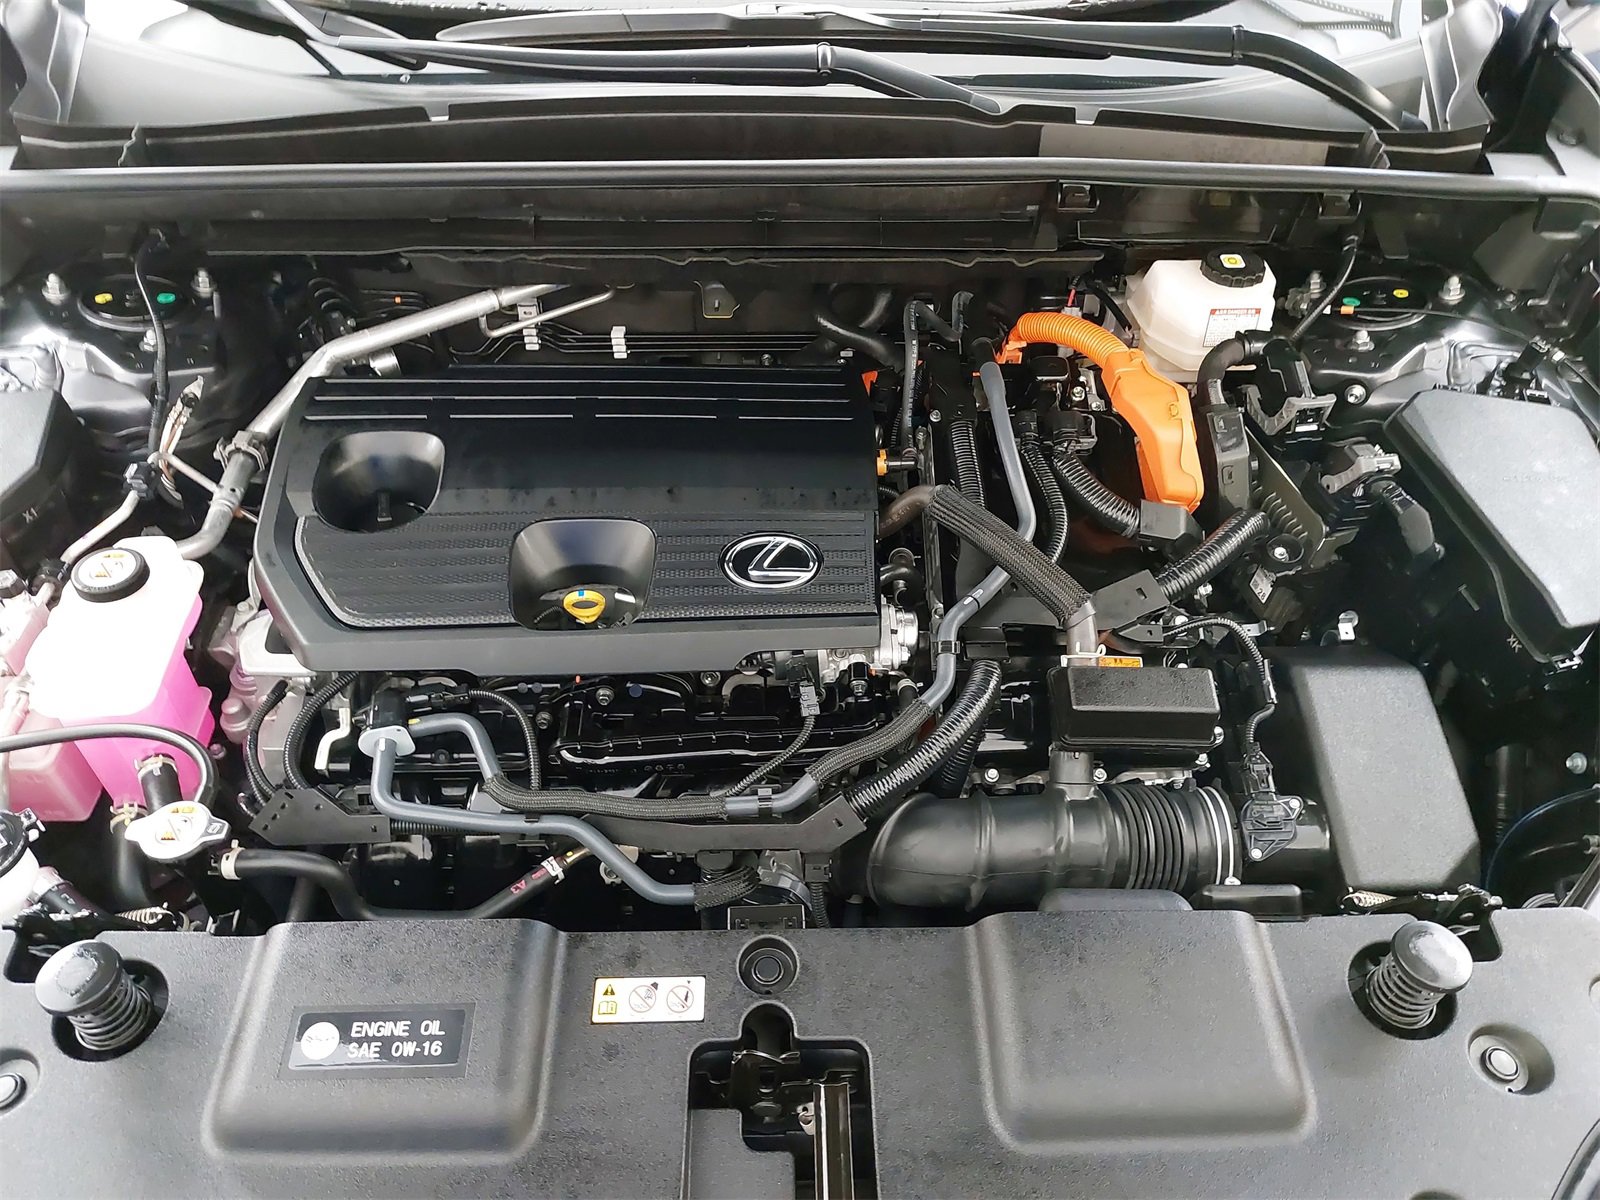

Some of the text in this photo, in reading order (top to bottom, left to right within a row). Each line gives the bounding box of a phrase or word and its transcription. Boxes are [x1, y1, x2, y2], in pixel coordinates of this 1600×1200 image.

[350, 1020, 446, 1037] ENGINE OIL
[347, 1041, 443, 1058] SAE 0W-16
